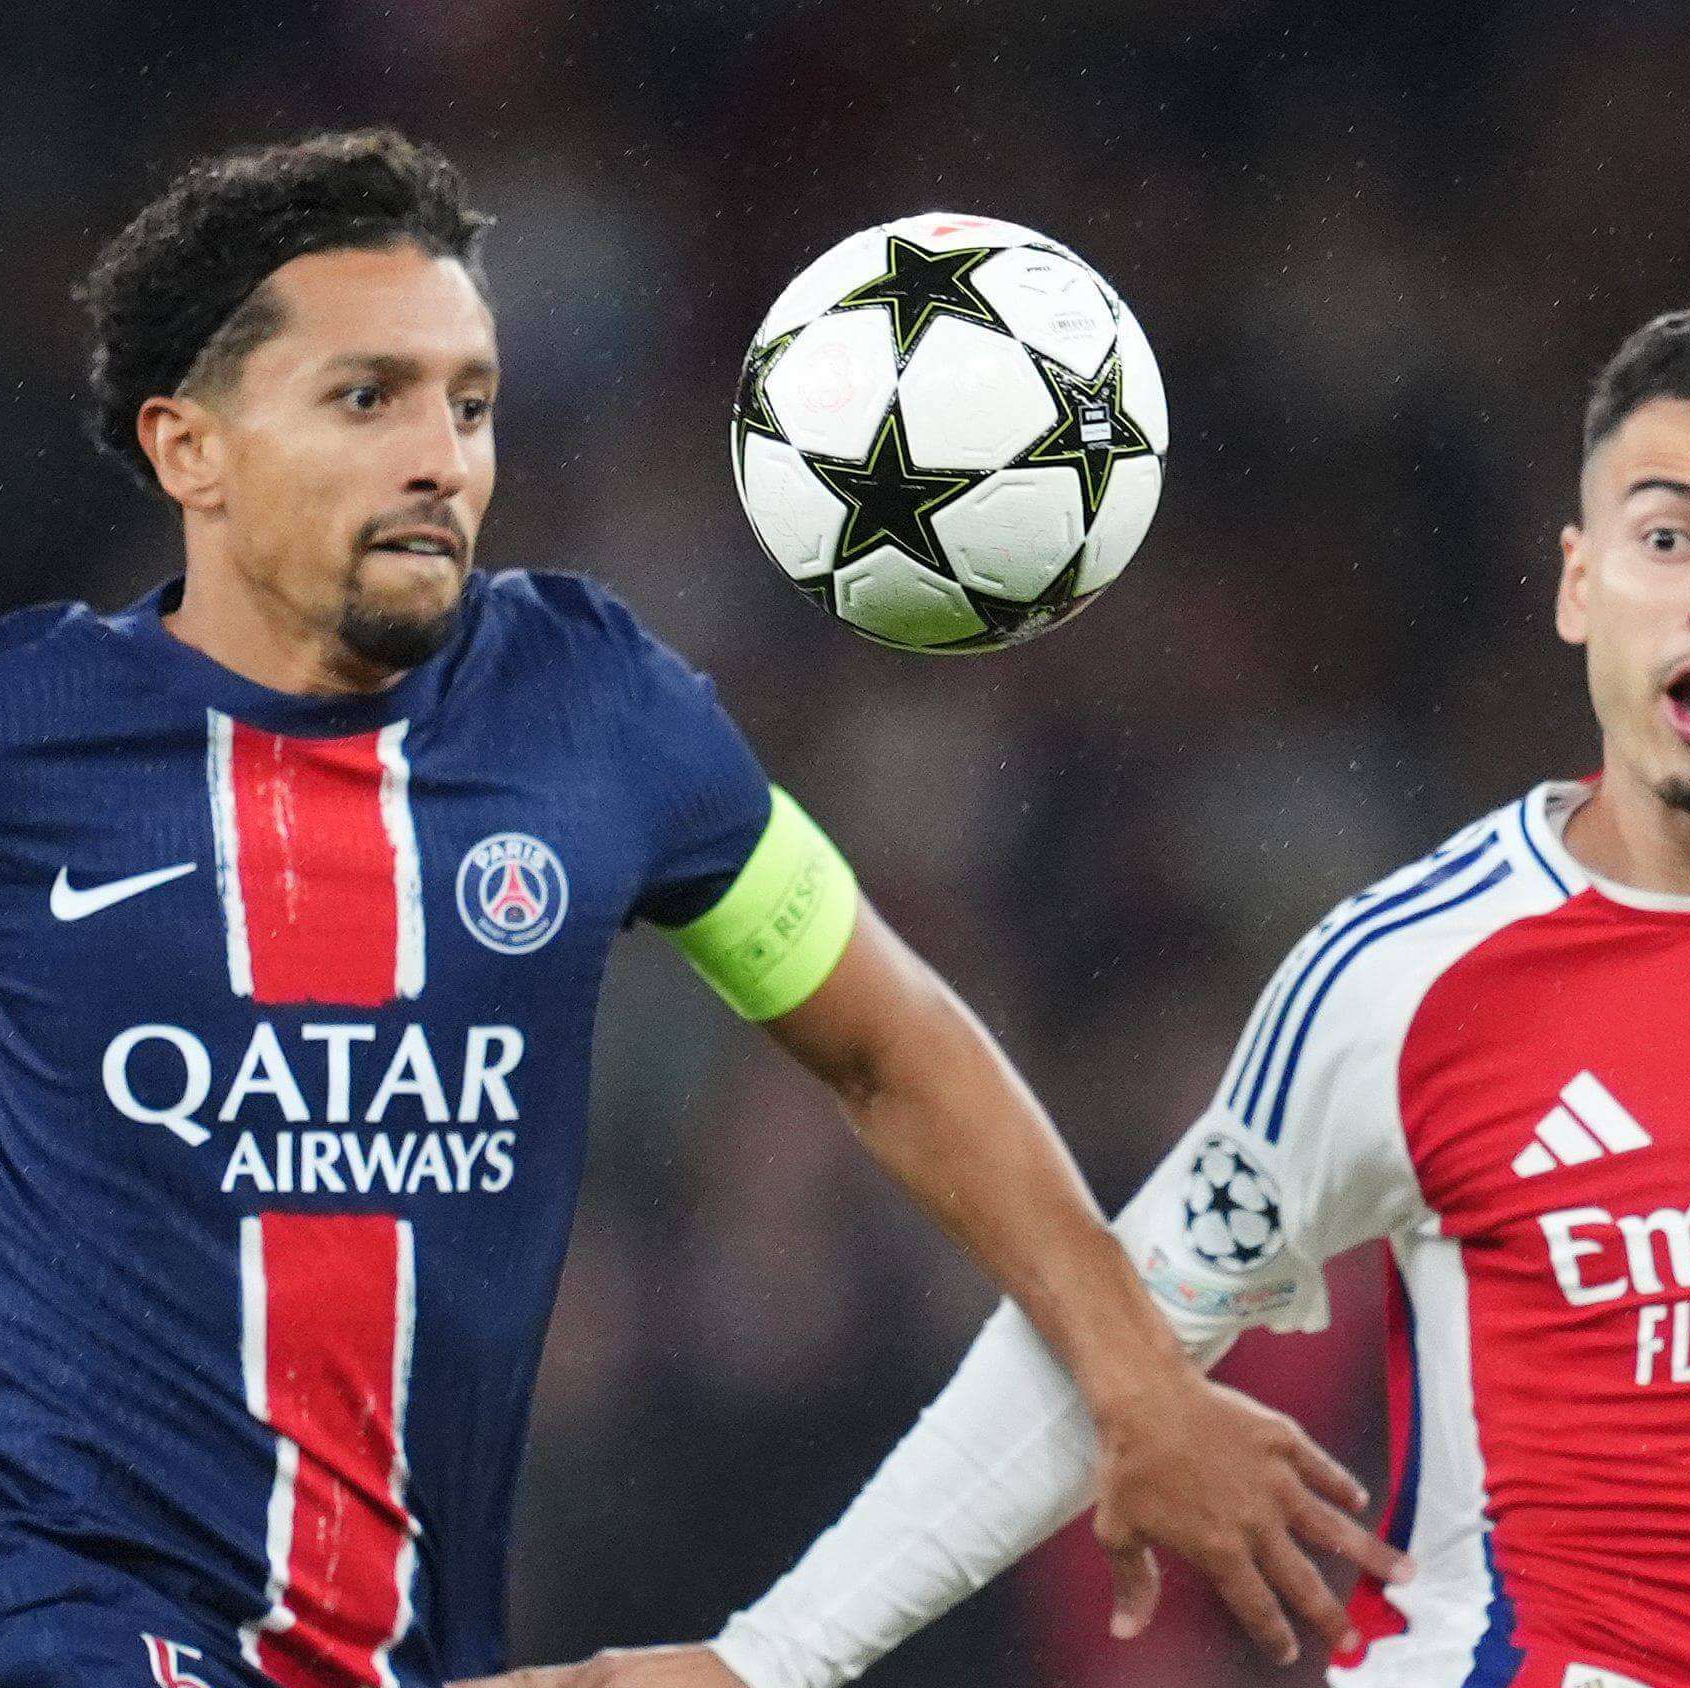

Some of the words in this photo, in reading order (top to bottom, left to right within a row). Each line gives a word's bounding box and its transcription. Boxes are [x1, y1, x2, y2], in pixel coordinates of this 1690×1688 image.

[473, 839, 549, 870] PARIS
[102, 1022, 524, 1147] QATAR
[220, 1130, 516, 1194] AIRWAYS
